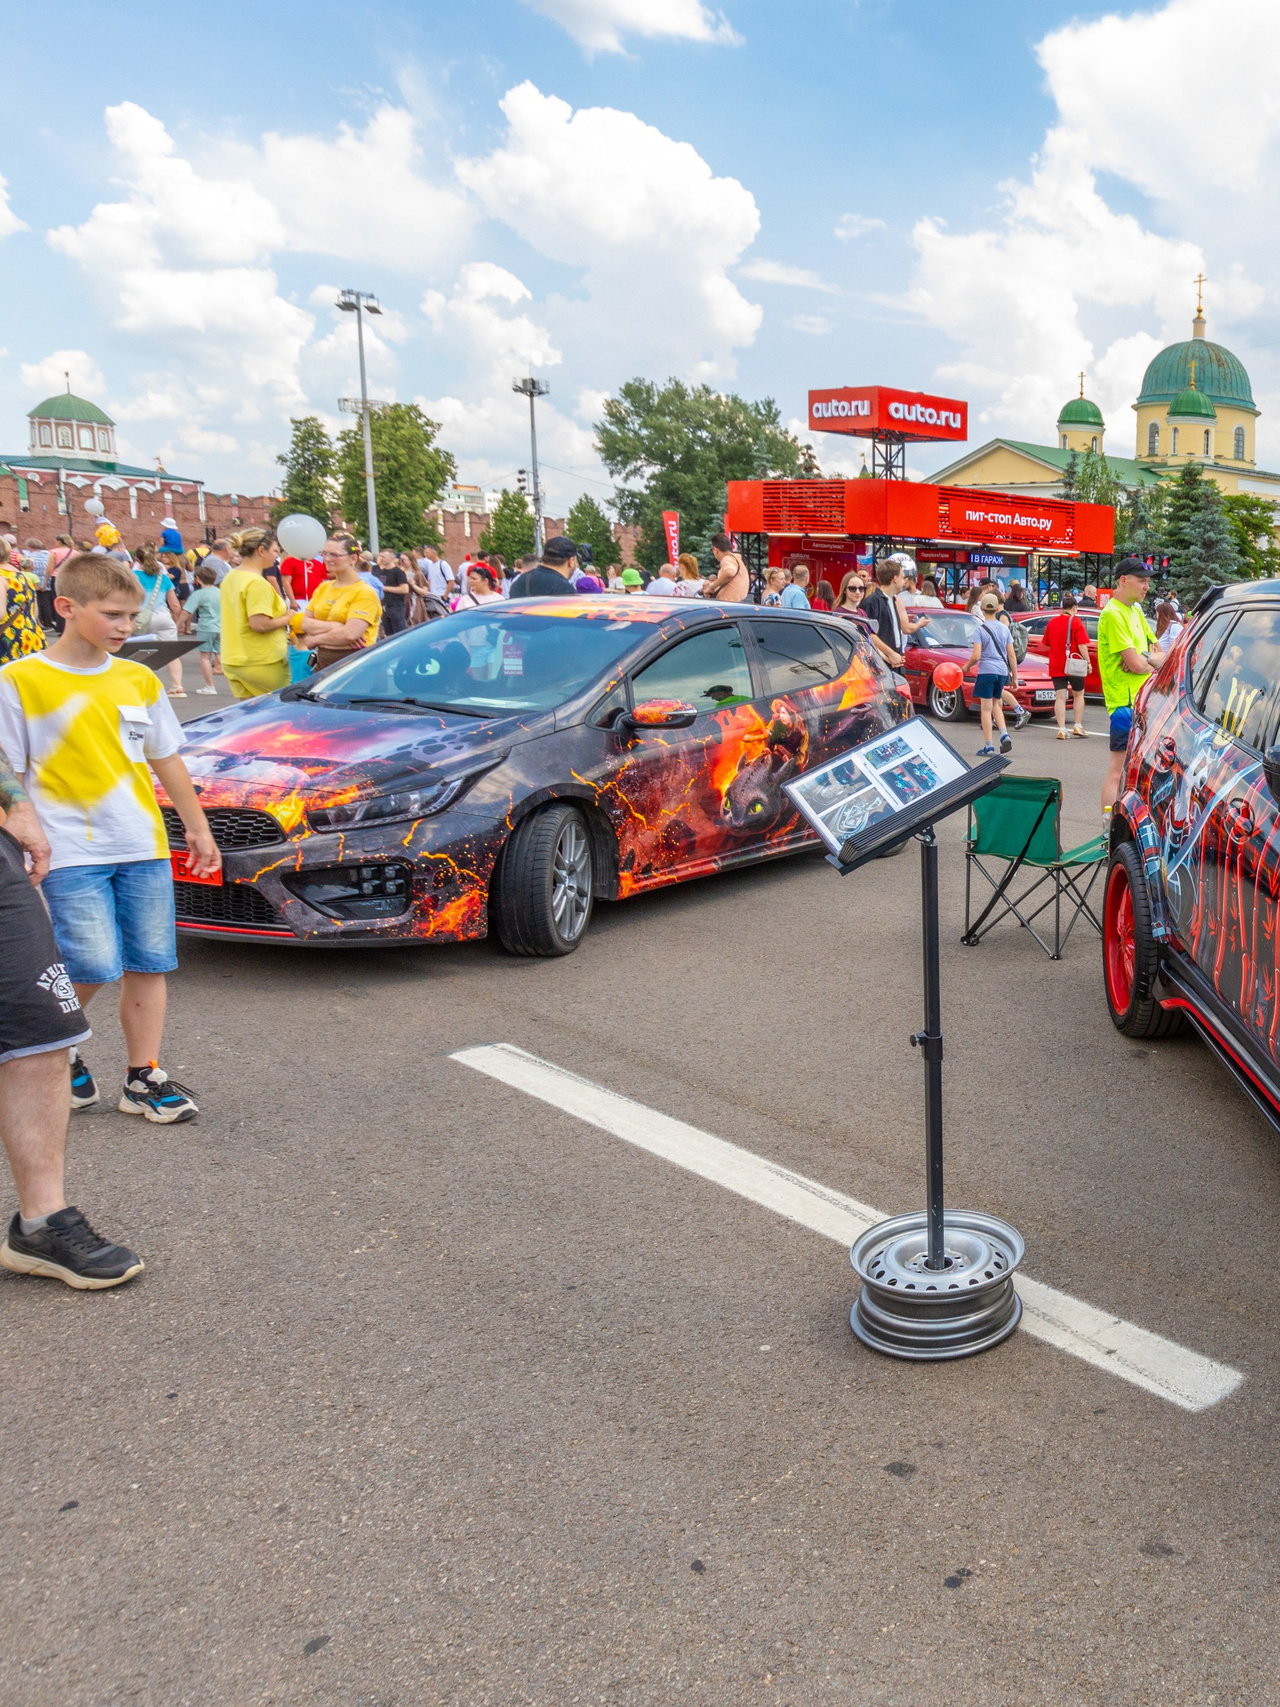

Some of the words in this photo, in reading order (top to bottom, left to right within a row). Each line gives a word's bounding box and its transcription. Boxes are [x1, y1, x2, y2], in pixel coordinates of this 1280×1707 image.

[812, 399, 870, 419] auto.ru
[888, 402, 961, 430] auto.ru
[965, 509, 1011, 526] пит-стоп
[1013, 511, 1053, 531] Авто.ру
[666, 520, 679, 564] uto.ru
[981, 555, 1003, 565] ГАРАЖ
[1038, 691, 1056, 699] Н512
